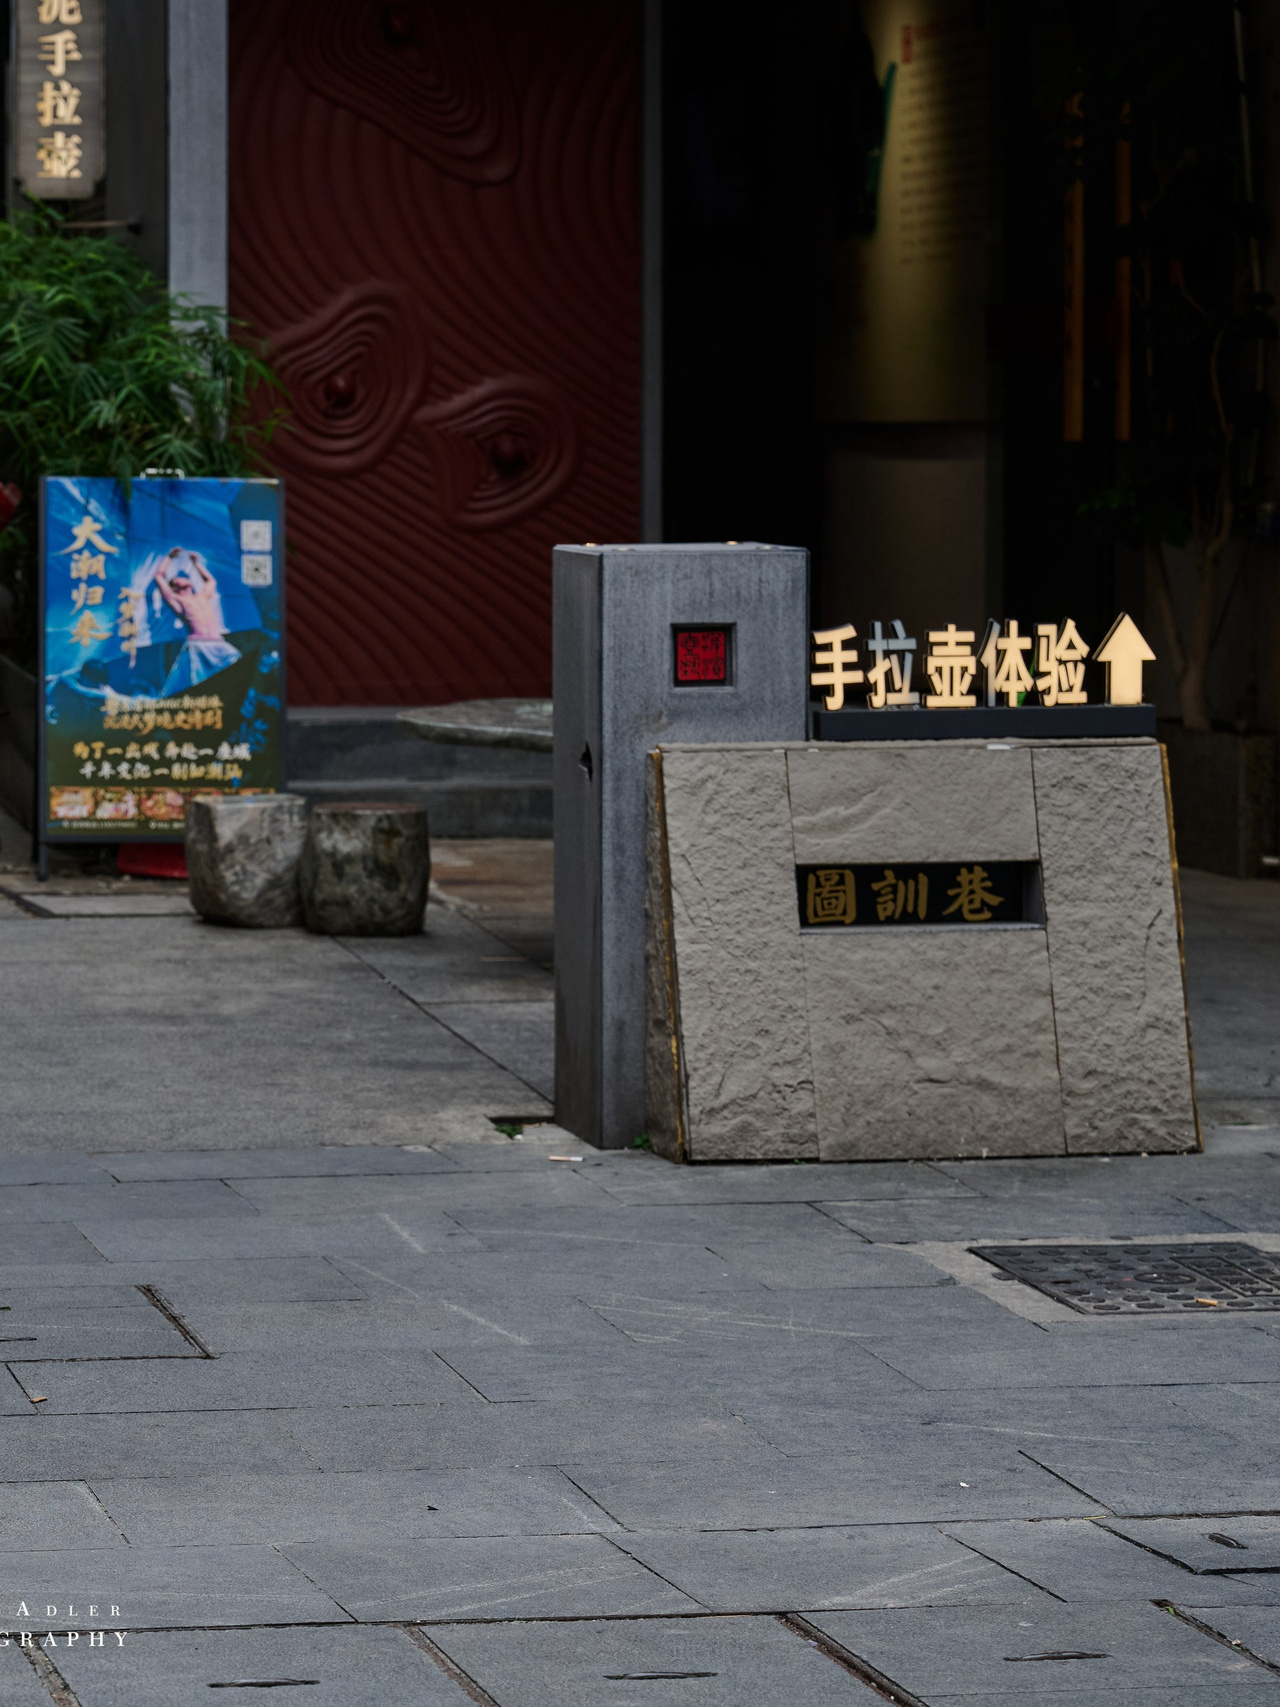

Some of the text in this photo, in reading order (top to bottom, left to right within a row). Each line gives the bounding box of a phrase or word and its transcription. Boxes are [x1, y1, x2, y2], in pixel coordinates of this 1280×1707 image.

[57, 515, 119, 647] 大潮归来
[810, 617, 1091, 712] 手拉壶体验
[806, 865, 1004, 925] 圖訓巷
